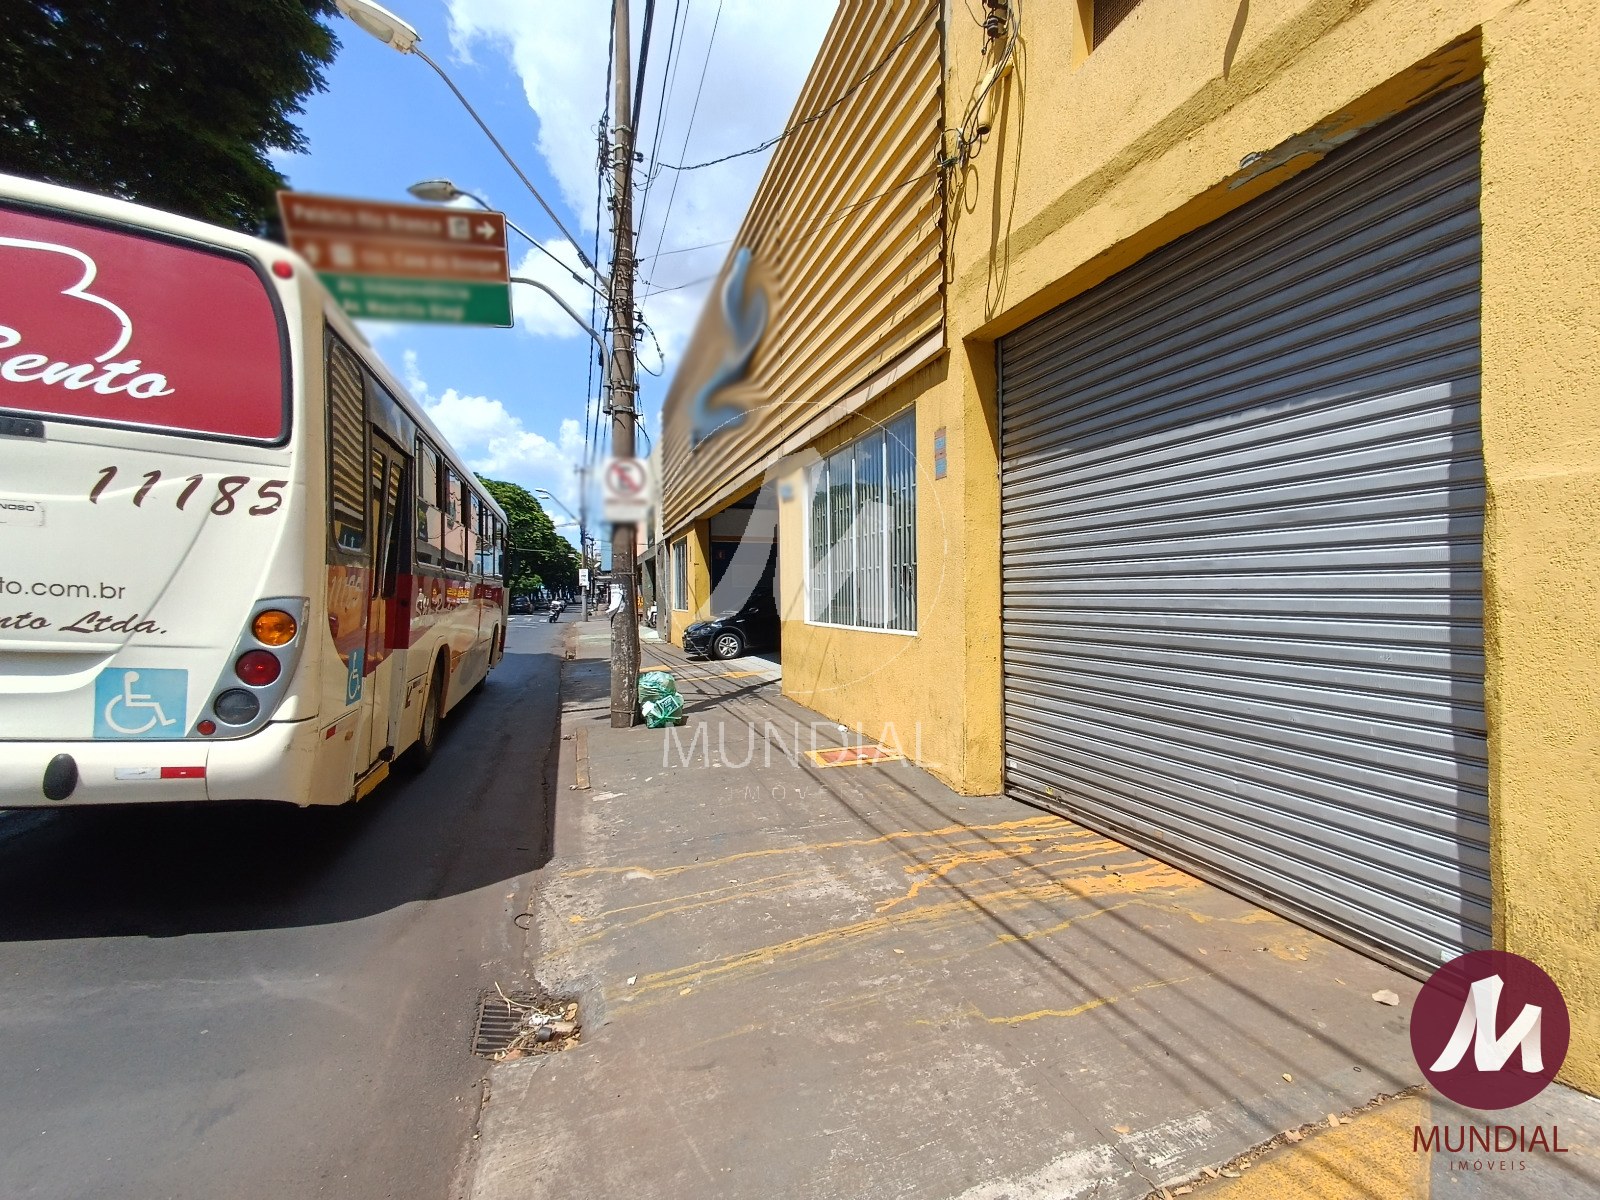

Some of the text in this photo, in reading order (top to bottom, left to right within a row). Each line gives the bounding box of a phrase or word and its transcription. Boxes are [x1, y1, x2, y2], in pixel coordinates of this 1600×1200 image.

[0, 326, 175, 399] ento
[89, 465, 289, 516] 11185
[58, 610, 167, 634] Ltda.
